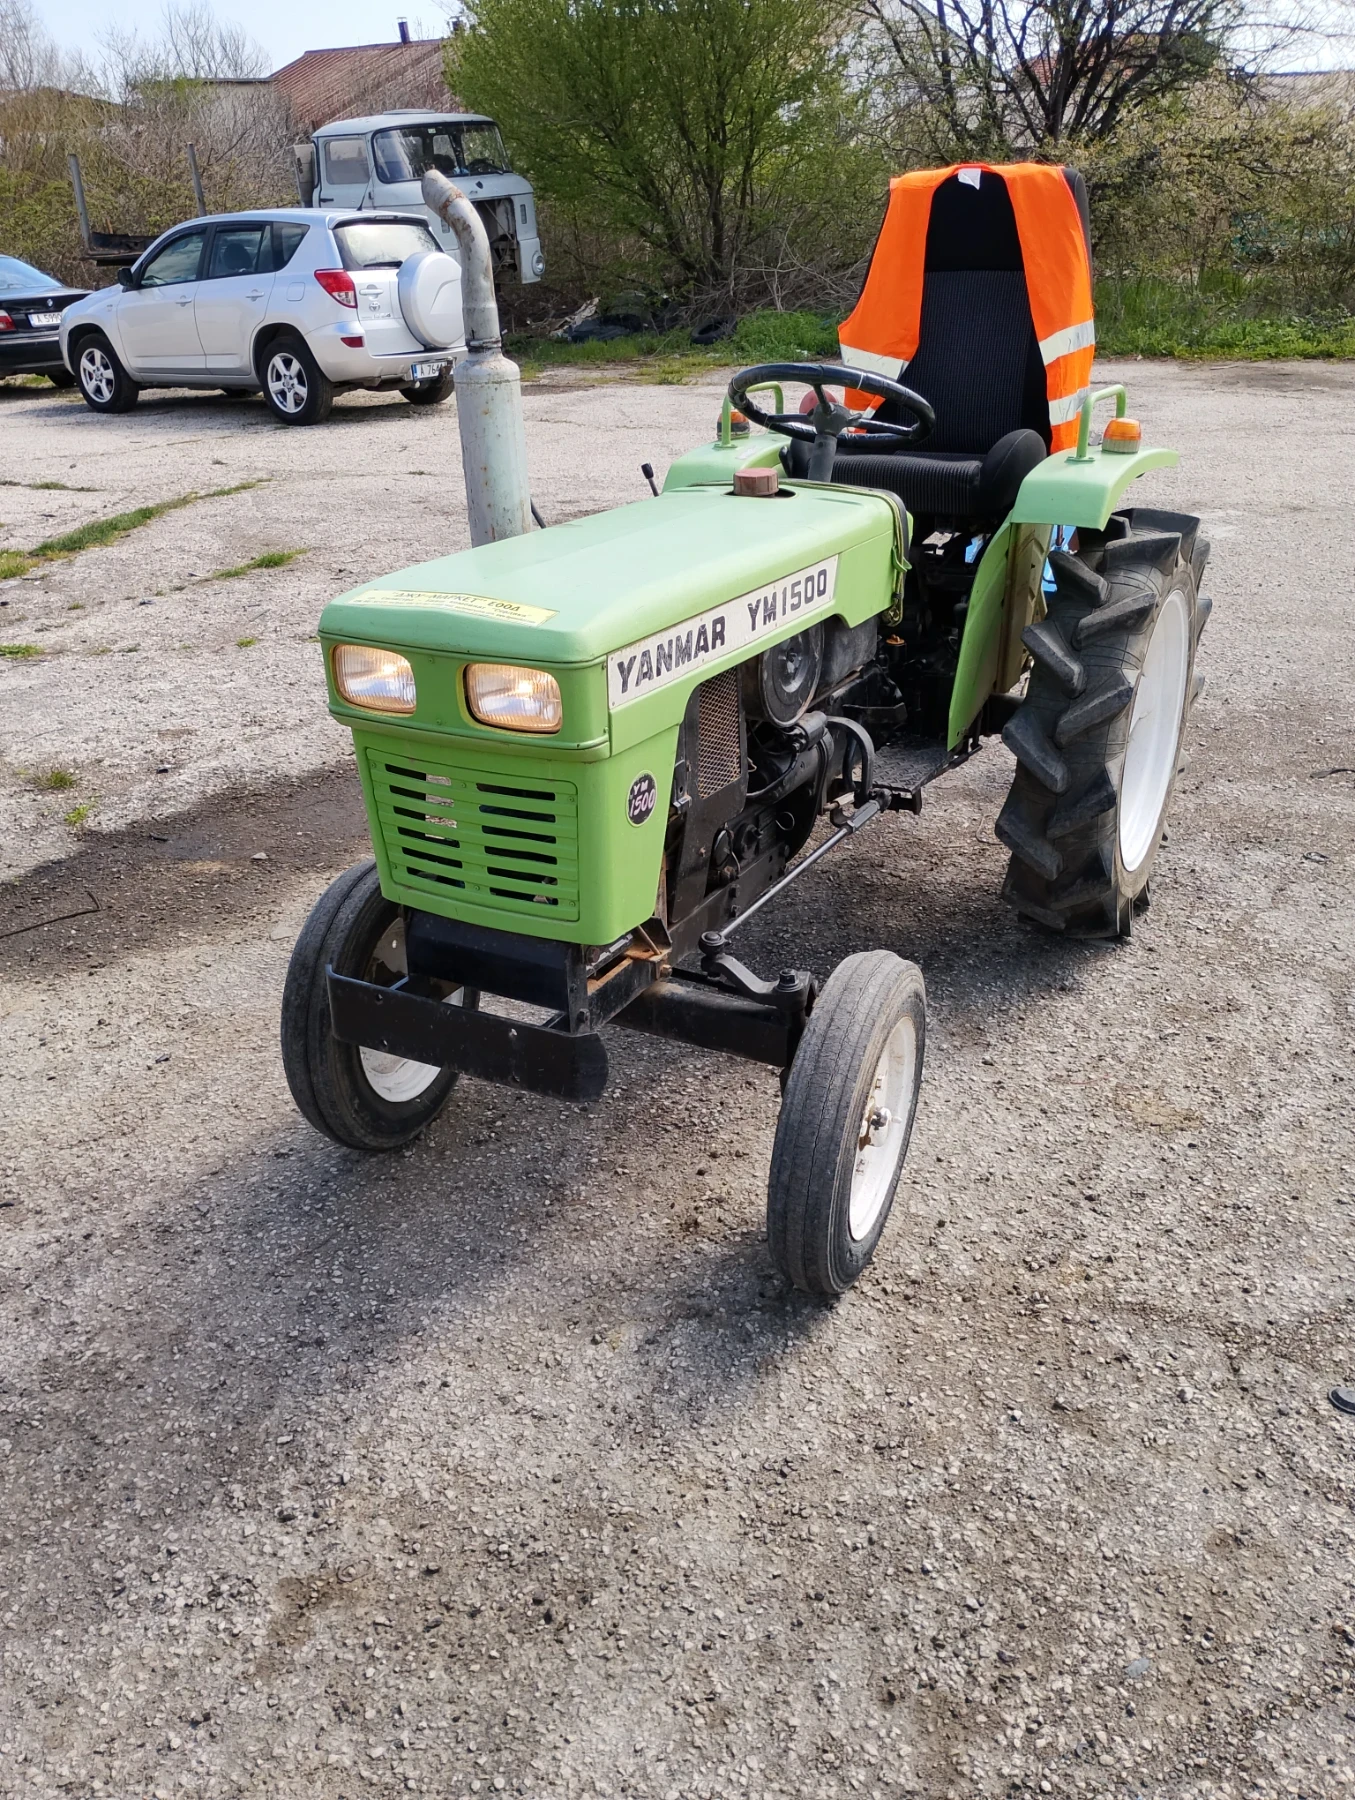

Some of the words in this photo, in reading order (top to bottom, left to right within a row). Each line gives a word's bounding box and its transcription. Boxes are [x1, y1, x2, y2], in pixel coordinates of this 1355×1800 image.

[617, 616, 726, 694] YANMAR
[747, 569, 828, 631] YM1500
[633, 779, 649, 796] YM
[629, 788, 656, 817] 1500
